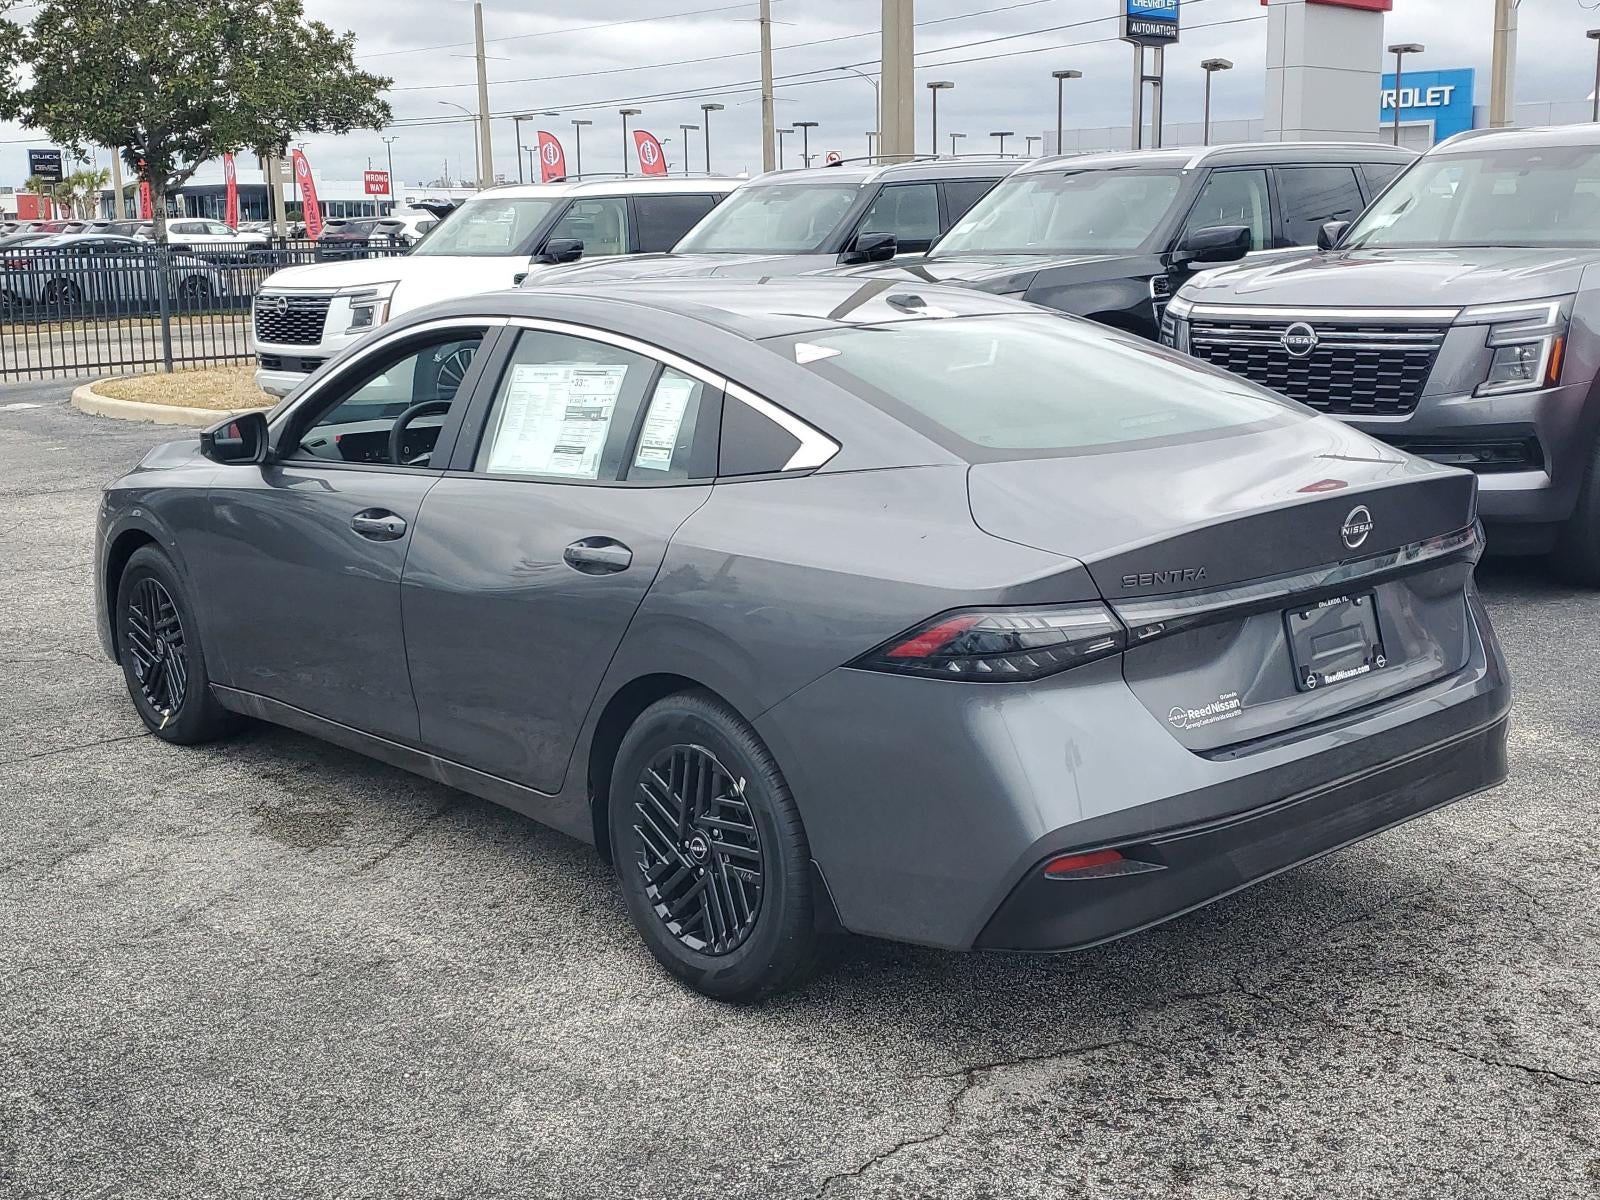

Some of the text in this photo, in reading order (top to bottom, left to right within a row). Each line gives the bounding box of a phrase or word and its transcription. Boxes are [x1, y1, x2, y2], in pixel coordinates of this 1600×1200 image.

[1131, 22, 1177, 36] AUTONATION
[34, 164, 59, 172] GMC
[365, 173, 389, 183] WRONG
[369, 183, 385, 192] WAY
[1342, 523, 1373, 535] NISSAN
[1121, 566, 1207, 588] SENTRA
[1324, 665, 1370, 684] ReedNissan.com
